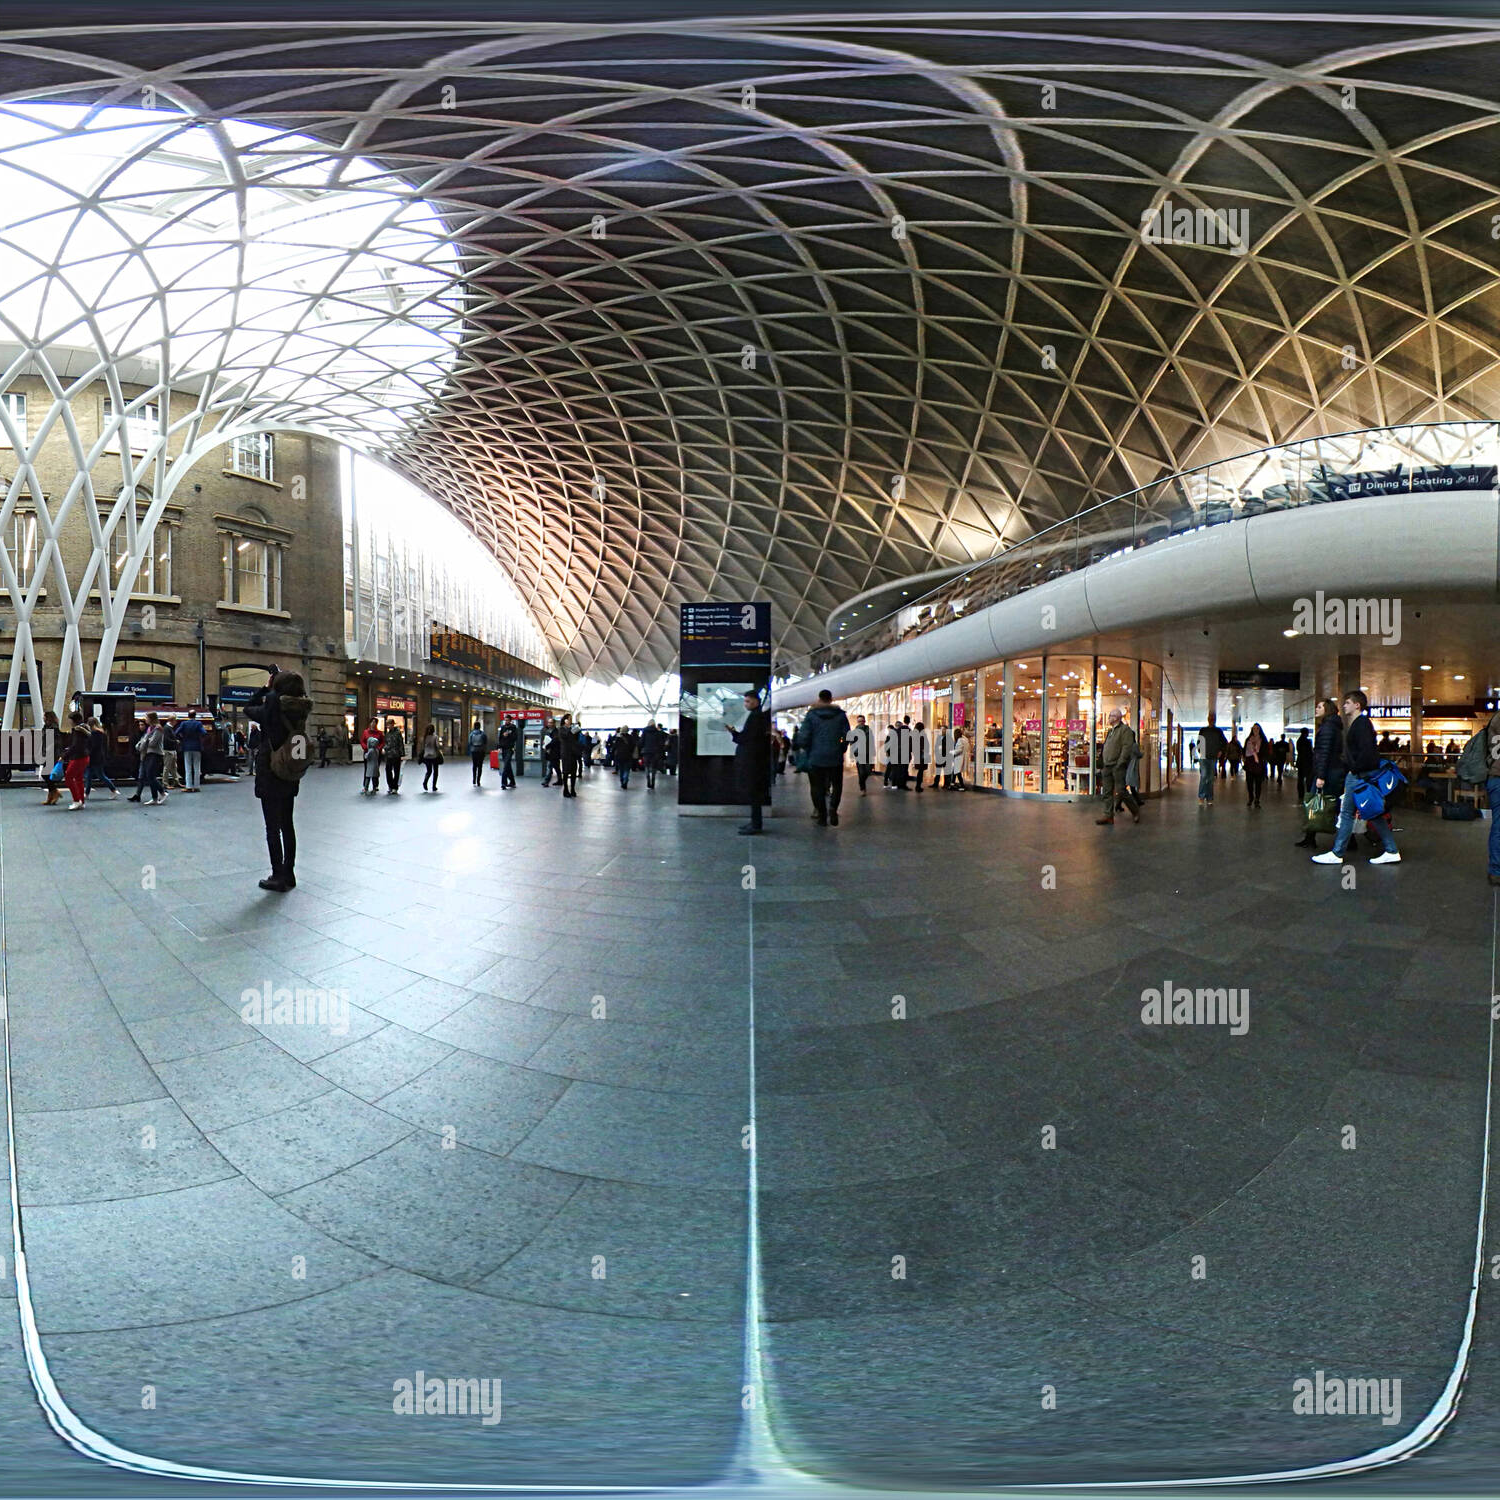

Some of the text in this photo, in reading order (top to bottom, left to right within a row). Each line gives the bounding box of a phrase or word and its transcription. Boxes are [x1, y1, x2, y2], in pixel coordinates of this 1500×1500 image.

[1366, 481, 1399, 490] Dining
[1413, 476, 1453, 486] Seating
[389, 699, 405, 709] LEON
